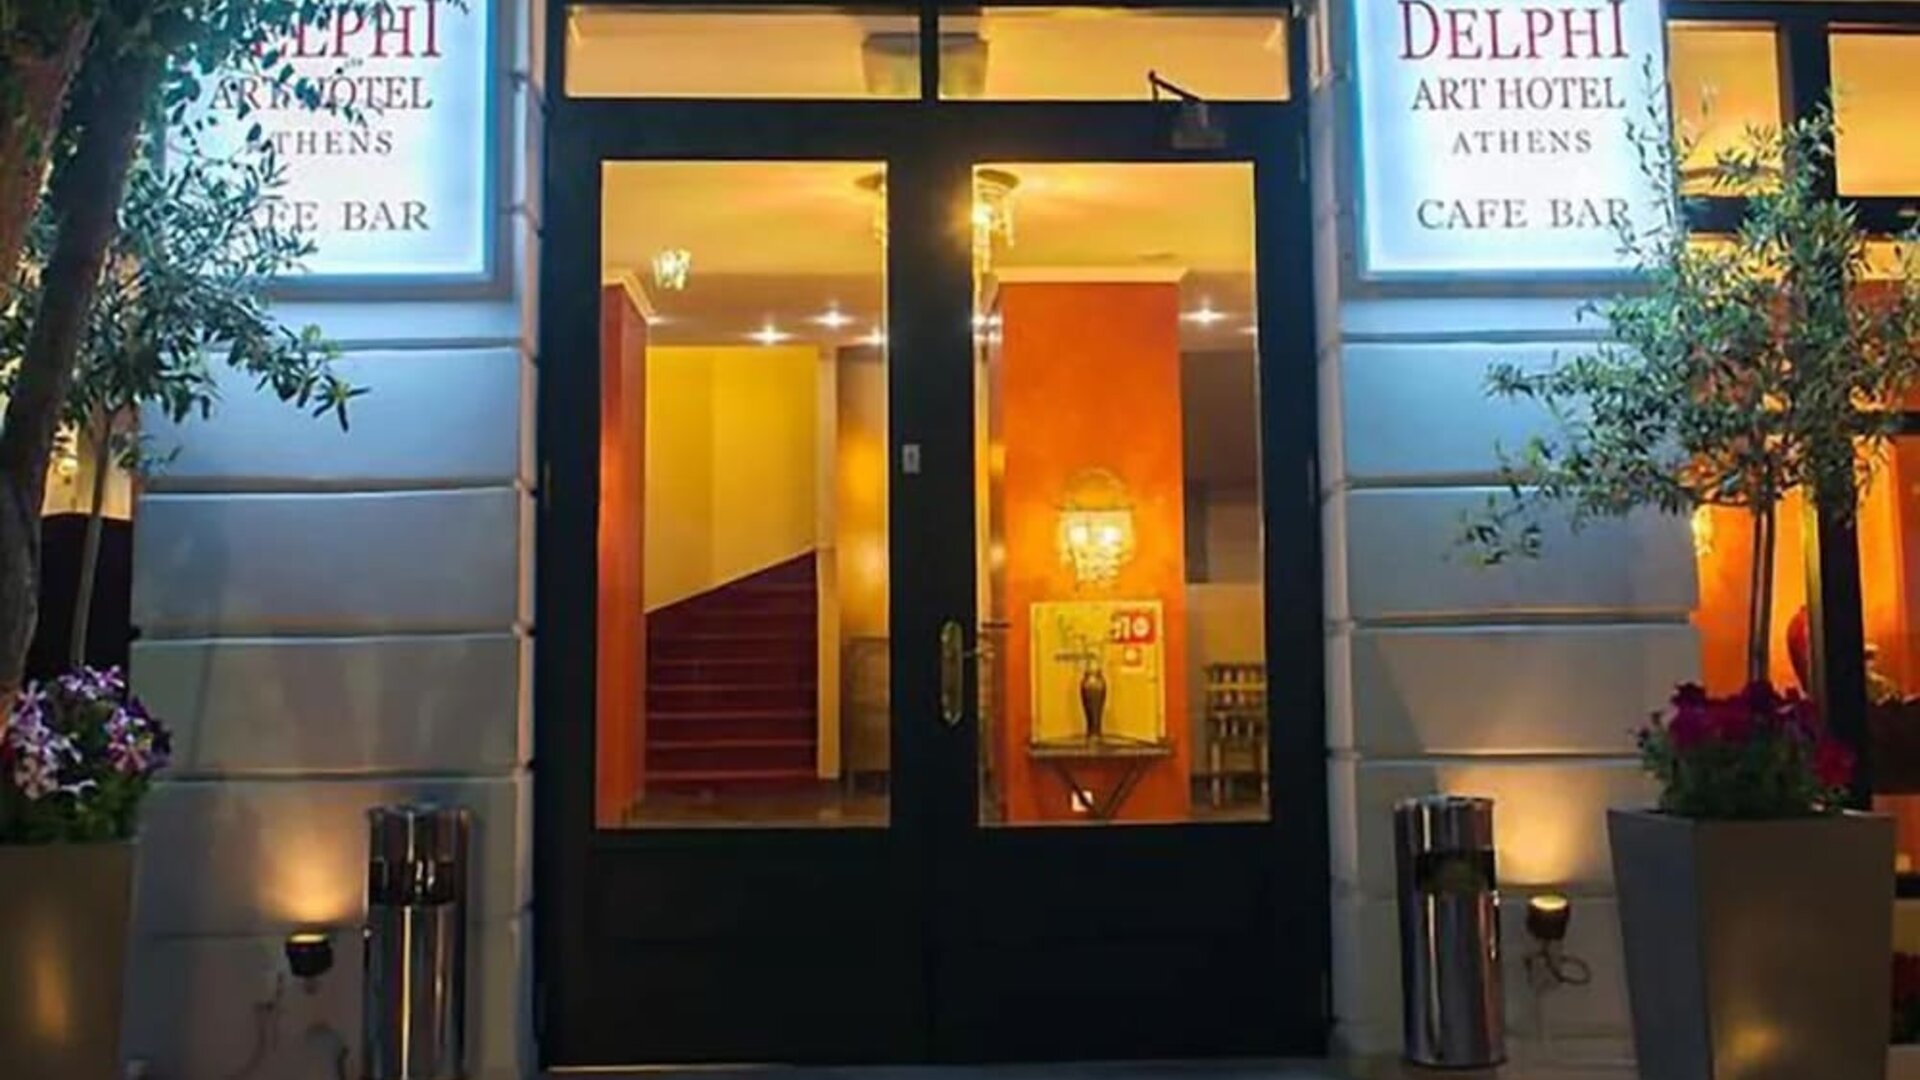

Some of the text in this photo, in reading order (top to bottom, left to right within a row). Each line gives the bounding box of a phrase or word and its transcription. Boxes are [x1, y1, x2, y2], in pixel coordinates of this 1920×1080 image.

[250, 0, 442, 57] LPHI
[1398, 0, 1630, 60] DELPHI
[1411, 76, 1626, 110] ART HOTEL
[252, 129, 395, 155] THENS
[1452, 130, 1592, 154] ATHENS
[342, 200, 431, 231] BAR
[1416, 199, 1633, 230] CAFE BAR
